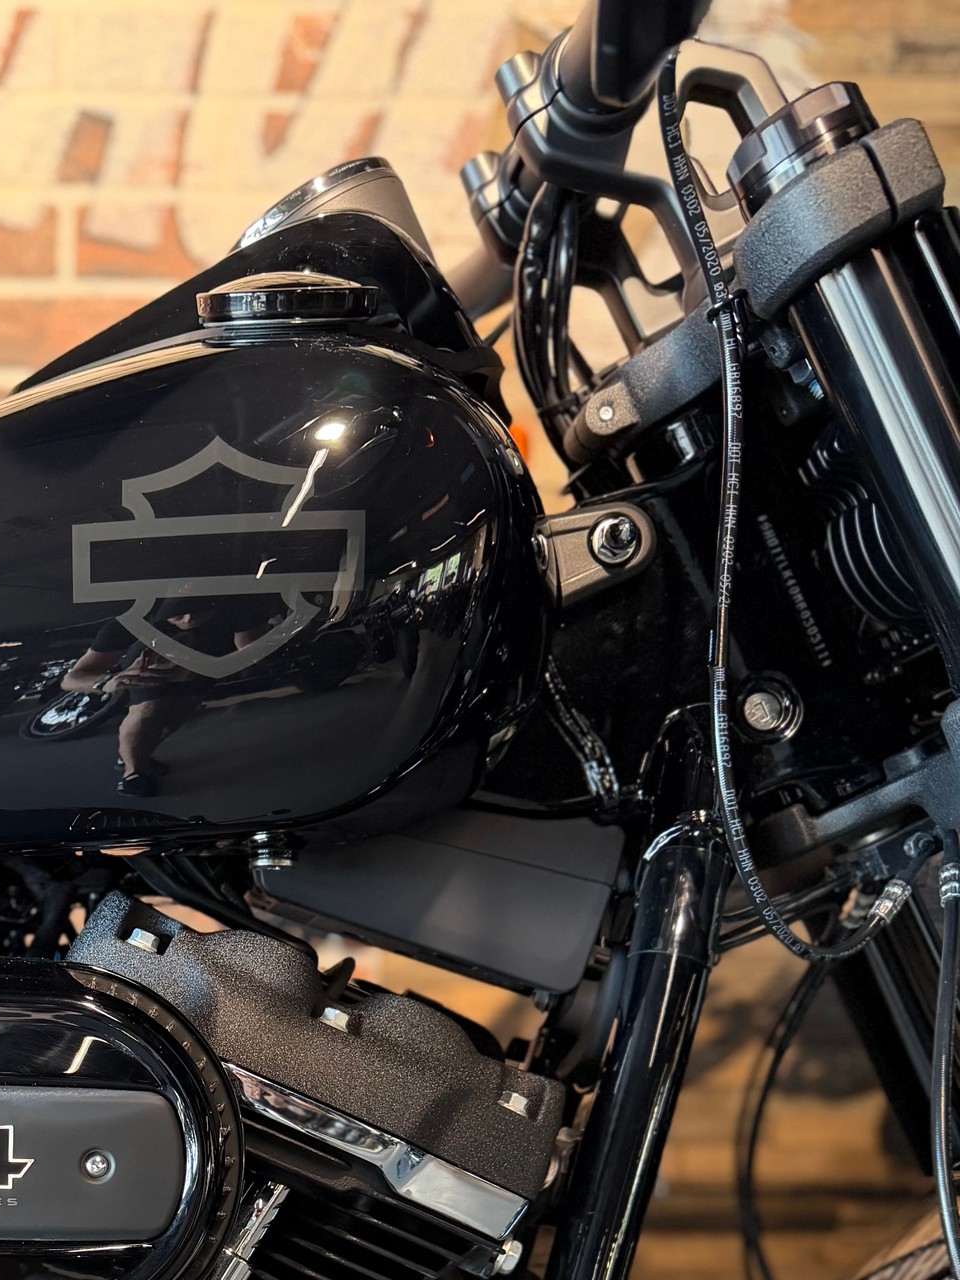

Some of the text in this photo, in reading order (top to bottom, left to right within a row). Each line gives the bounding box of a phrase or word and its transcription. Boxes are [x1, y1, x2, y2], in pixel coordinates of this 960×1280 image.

[672, 154, 690, 181] HHN
[680, 184, 701, 216] 0302
[694, 220, 722, 277] 05/2020
[729, 363, 741, 418] GB16897
[721, 535, 734, 564] 0302
[717, 713, 731, 767] GB16897
[736, 847, 755, 872] HHN
[746, 874, 768, 904] 0302
